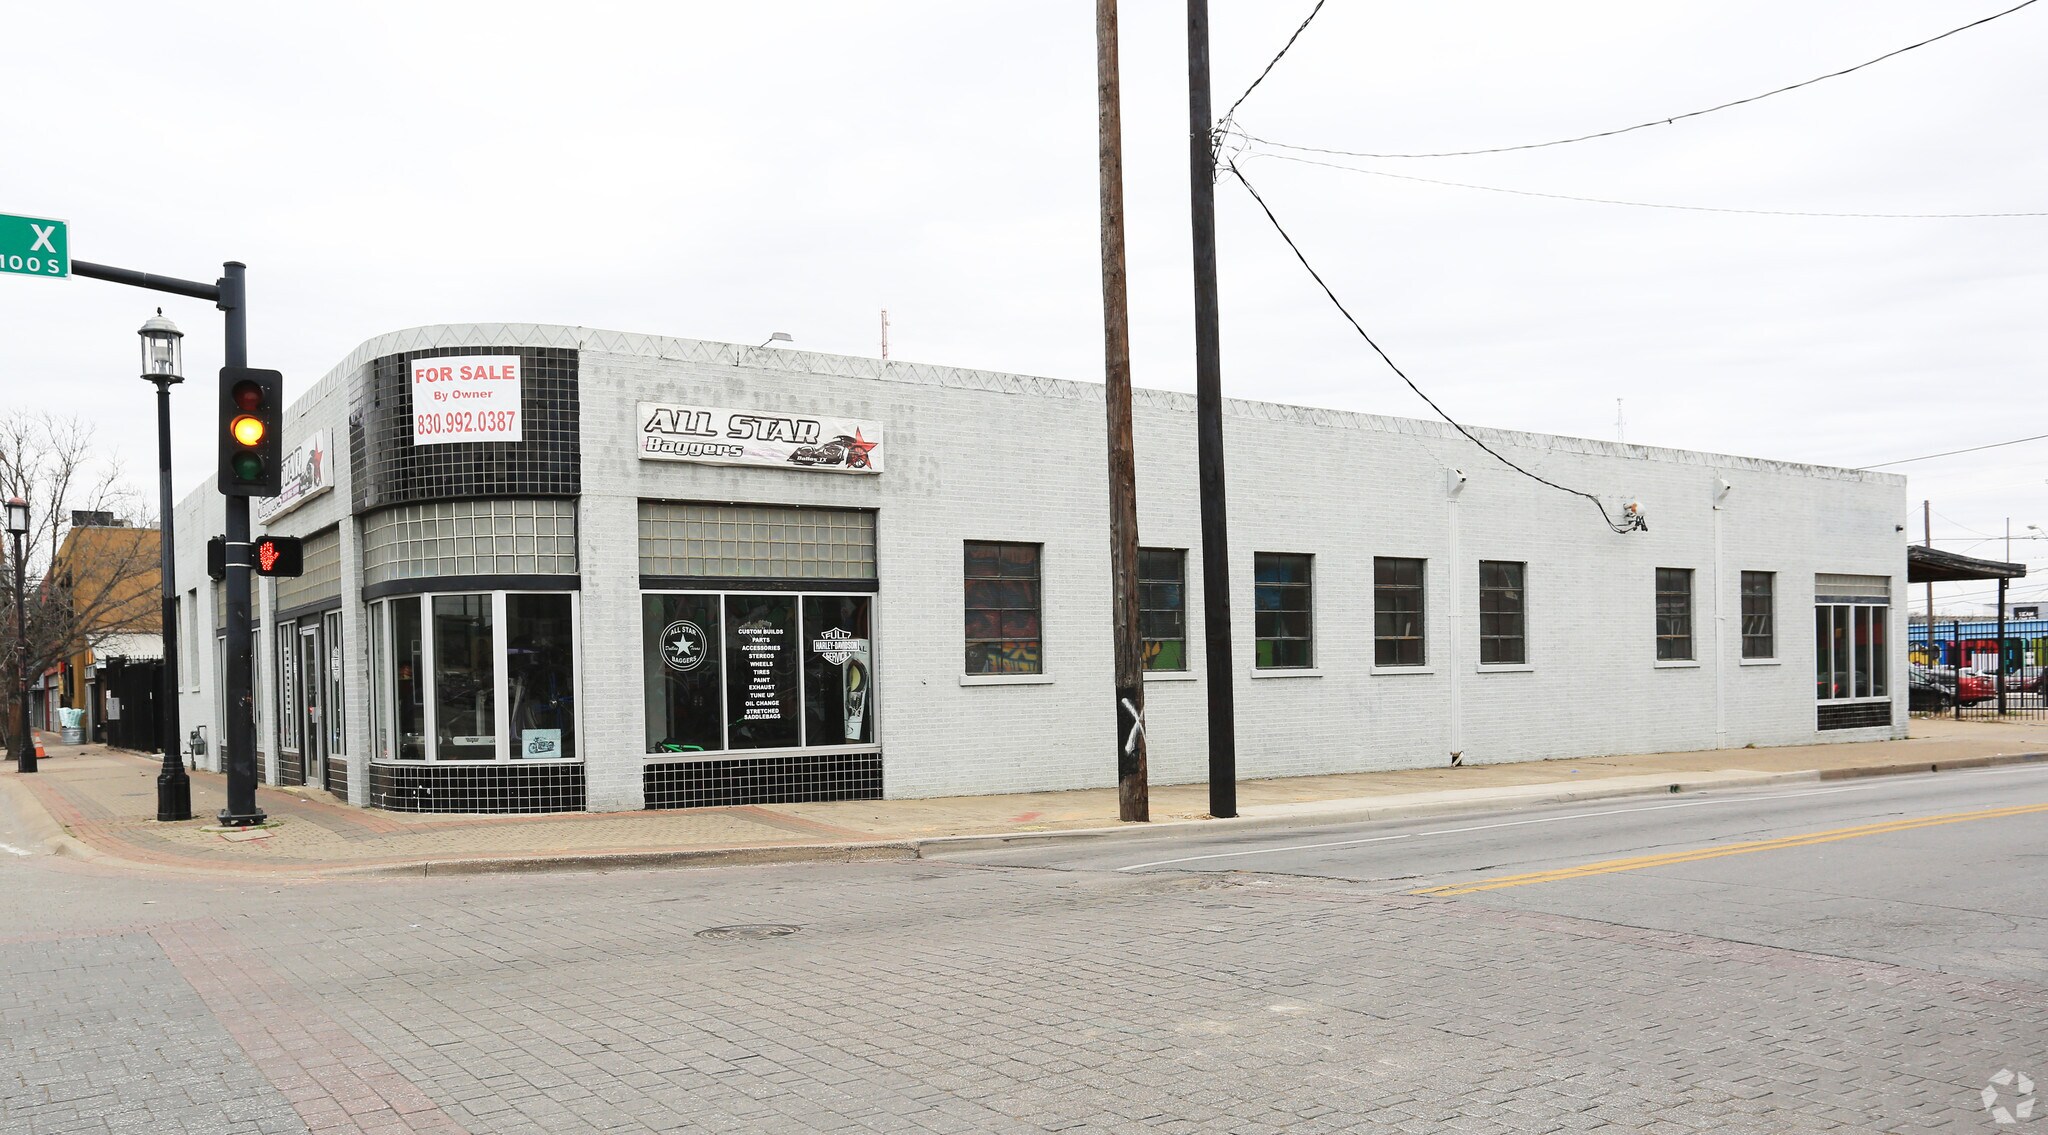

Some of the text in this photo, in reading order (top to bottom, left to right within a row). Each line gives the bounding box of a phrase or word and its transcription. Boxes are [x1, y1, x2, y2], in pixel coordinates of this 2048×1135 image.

[30, 223, 57, 253] X
[0, 254, 60, 274] 100 S
[415, 365, 515, 384] FOR SALE
[434, 389, 493, 402] By Owner
[417, 410, 516, 436] 830.992.0387
[643, 408, 821, 444] ALL STAR
[645, 436, 745, 458] Baggers
[670, 626, 697, 636] ALL STAR
[825, 629, 850, 640] FULL
[815, 641, 858, 650] HARLEY-DAVIDSON
[671, 655, 697, 664] BAGGERS
